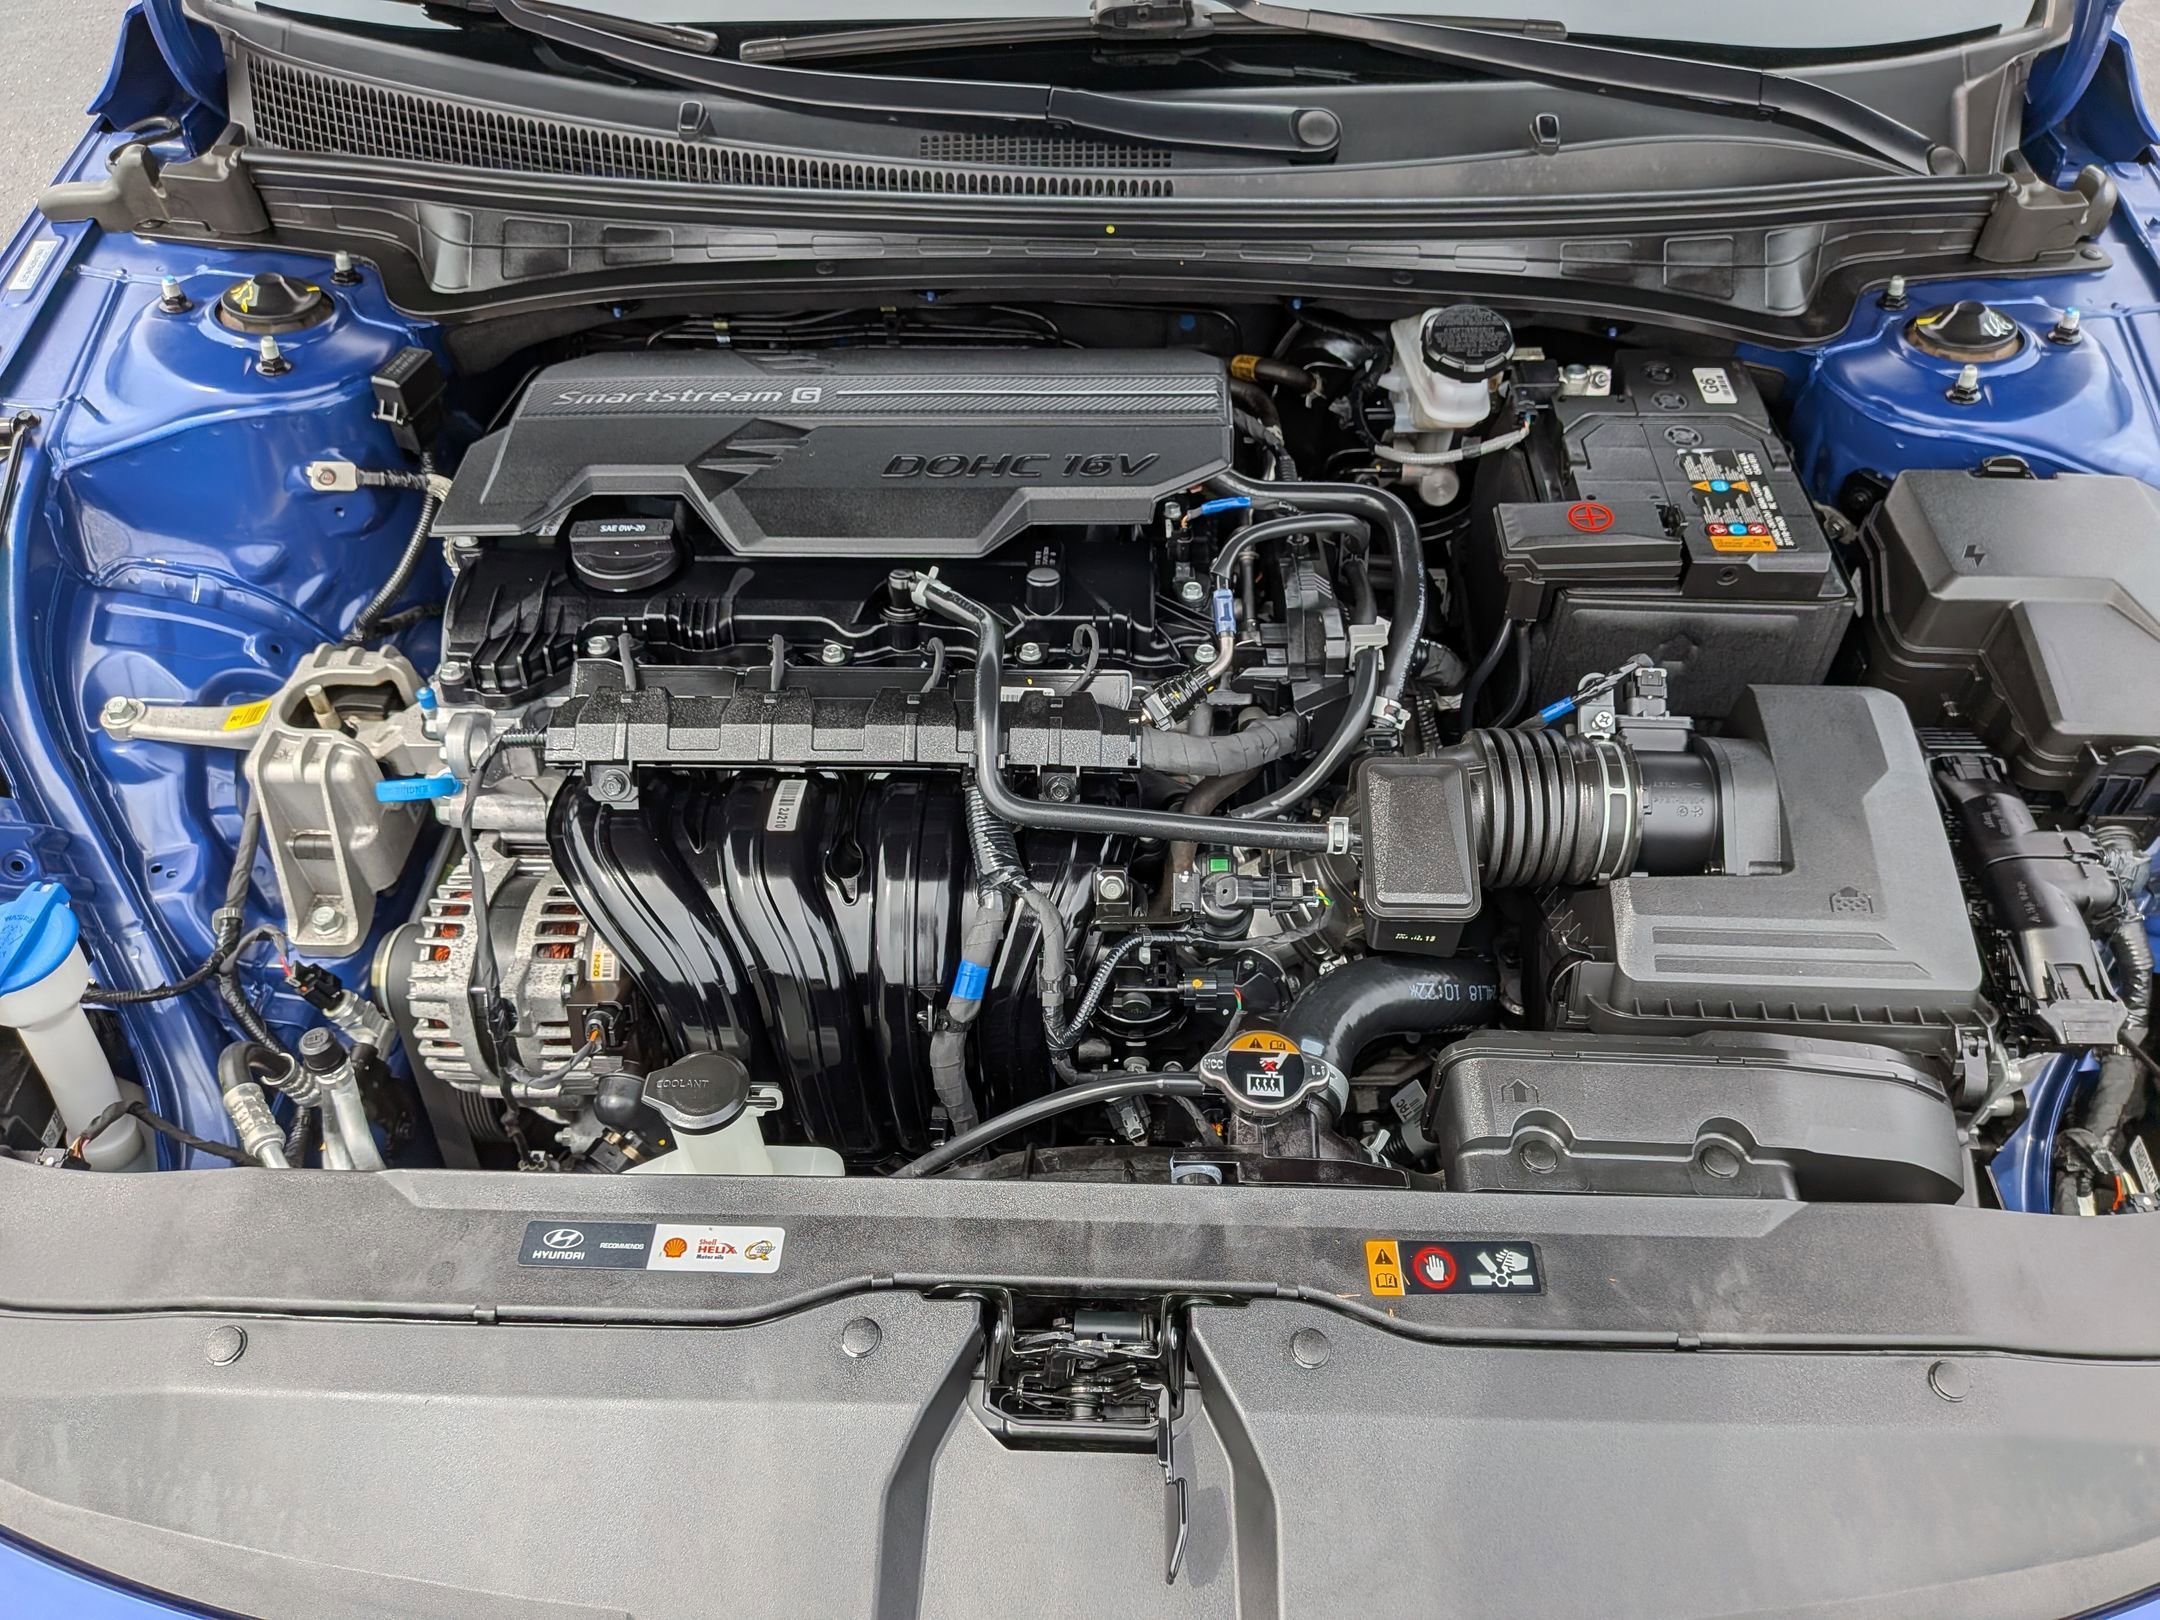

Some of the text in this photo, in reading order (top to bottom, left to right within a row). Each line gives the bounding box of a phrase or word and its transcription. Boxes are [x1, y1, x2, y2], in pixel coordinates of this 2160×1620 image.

[1700, 377, 1720, 394] G6
[554, 387, 822, 408] Smartstream G
[880, 452, 1161, 479] DOHC 16V
[600, 524, 646, 533] SAE 0W-20
[774, 807, 791, 829] 2J210
[593, 953, 601, 978] N20
[656, 1078, 709, 1089] COOLANT
[1396, 1098, 1412, 1122] TAC
[532, 1250, 585, 1260] HYUNDAI
[599, 1242, 645, 1251] RECOMMENDS
[698, 1245, 737, 1254] HELIX
